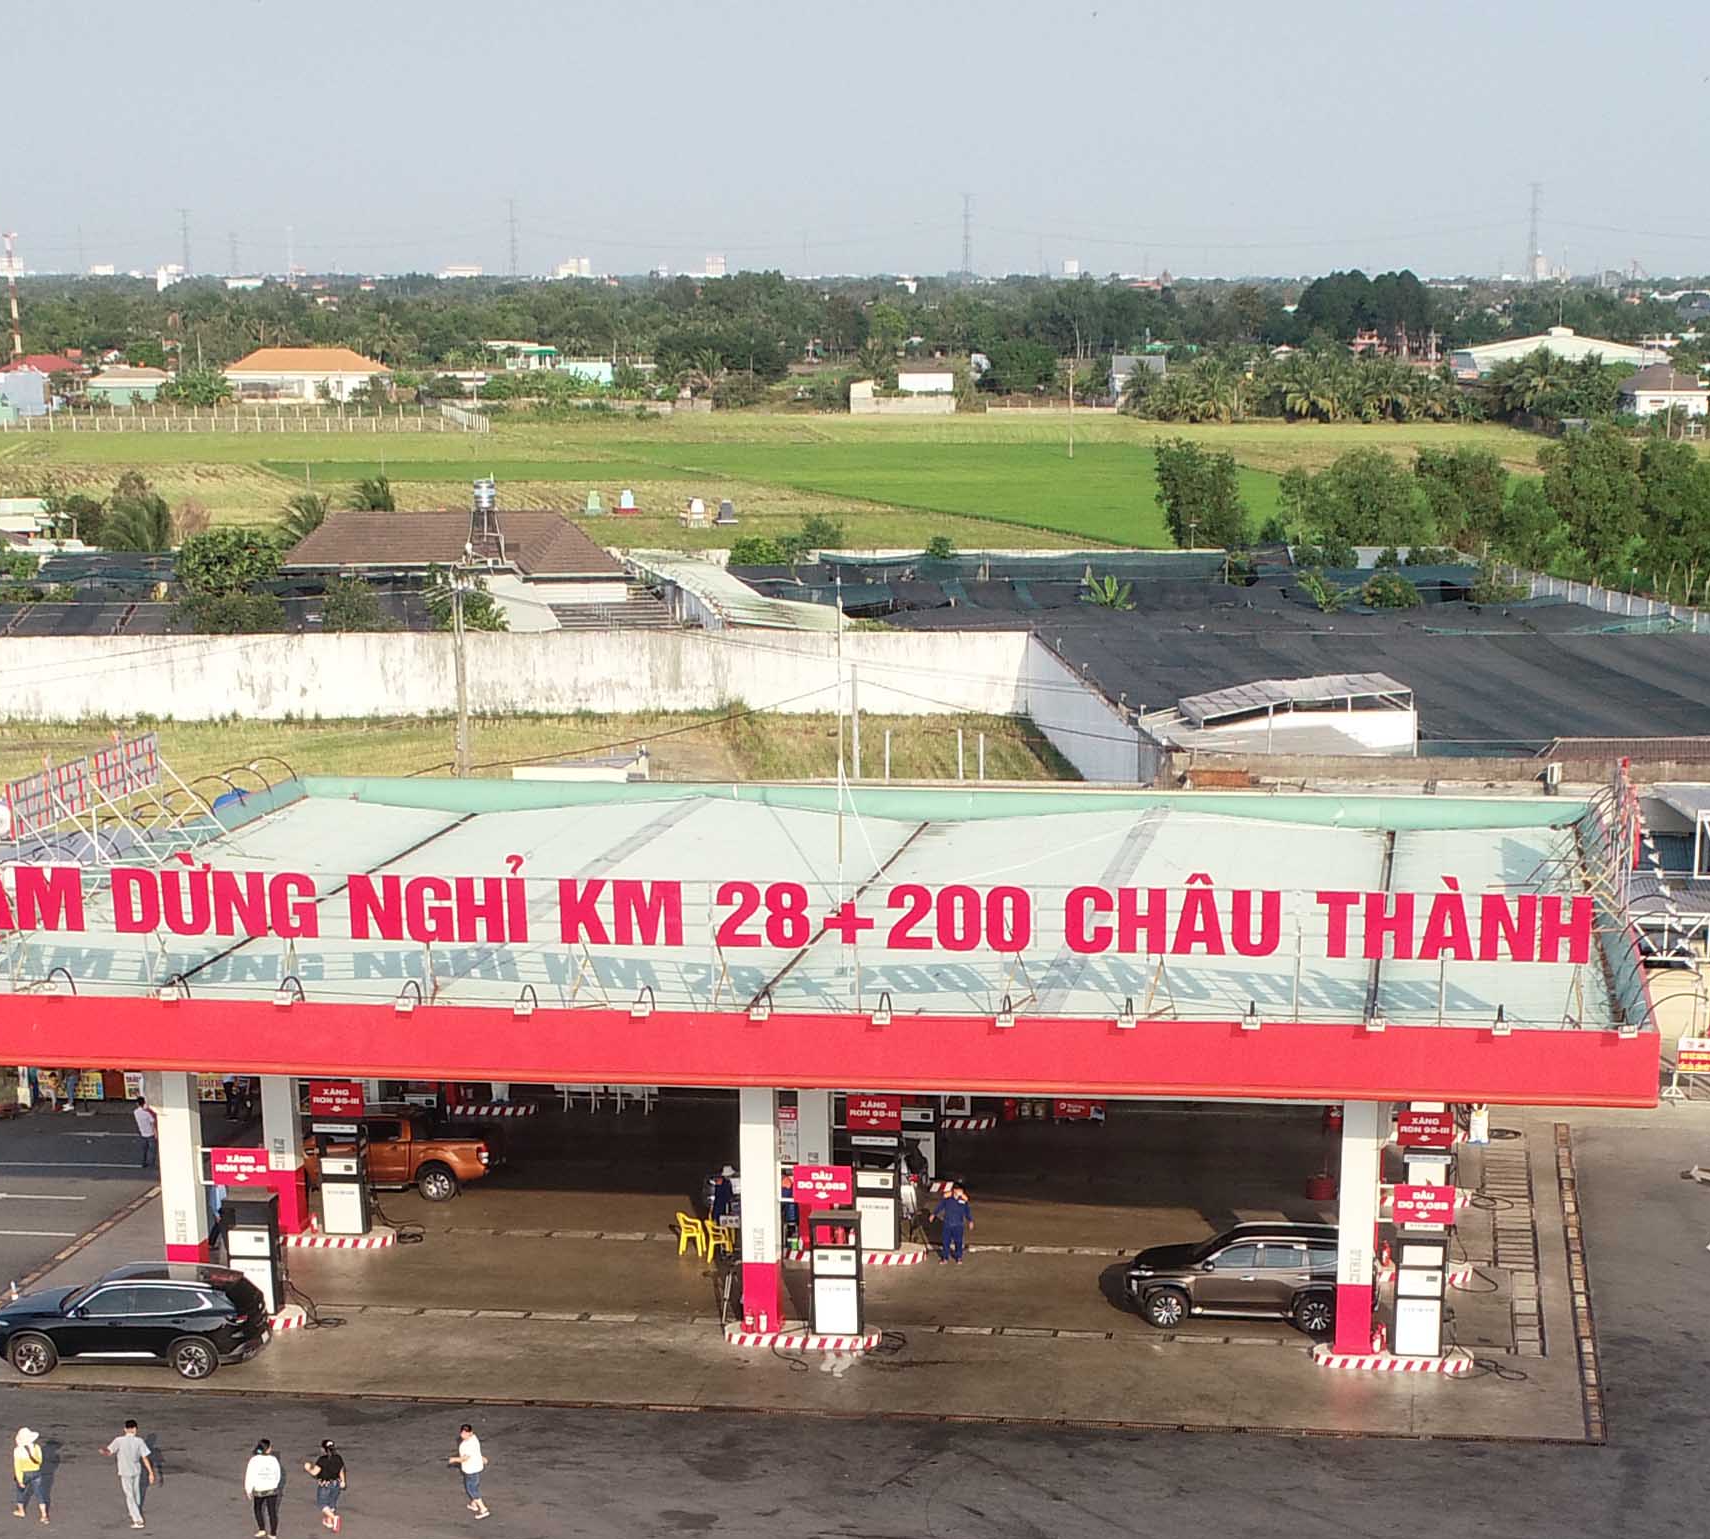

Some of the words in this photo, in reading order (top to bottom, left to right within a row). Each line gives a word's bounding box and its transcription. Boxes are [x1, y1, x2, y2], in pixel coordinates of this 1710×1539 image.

[110, 852, 320, 938] DỪNG
[347, 855, 529, 944] NGHỈ
[558, 878, 685, 946] KM
[1064, 873, 1281, 958] CHÂU
[1316, 874, 1592, 965] THÀNH
